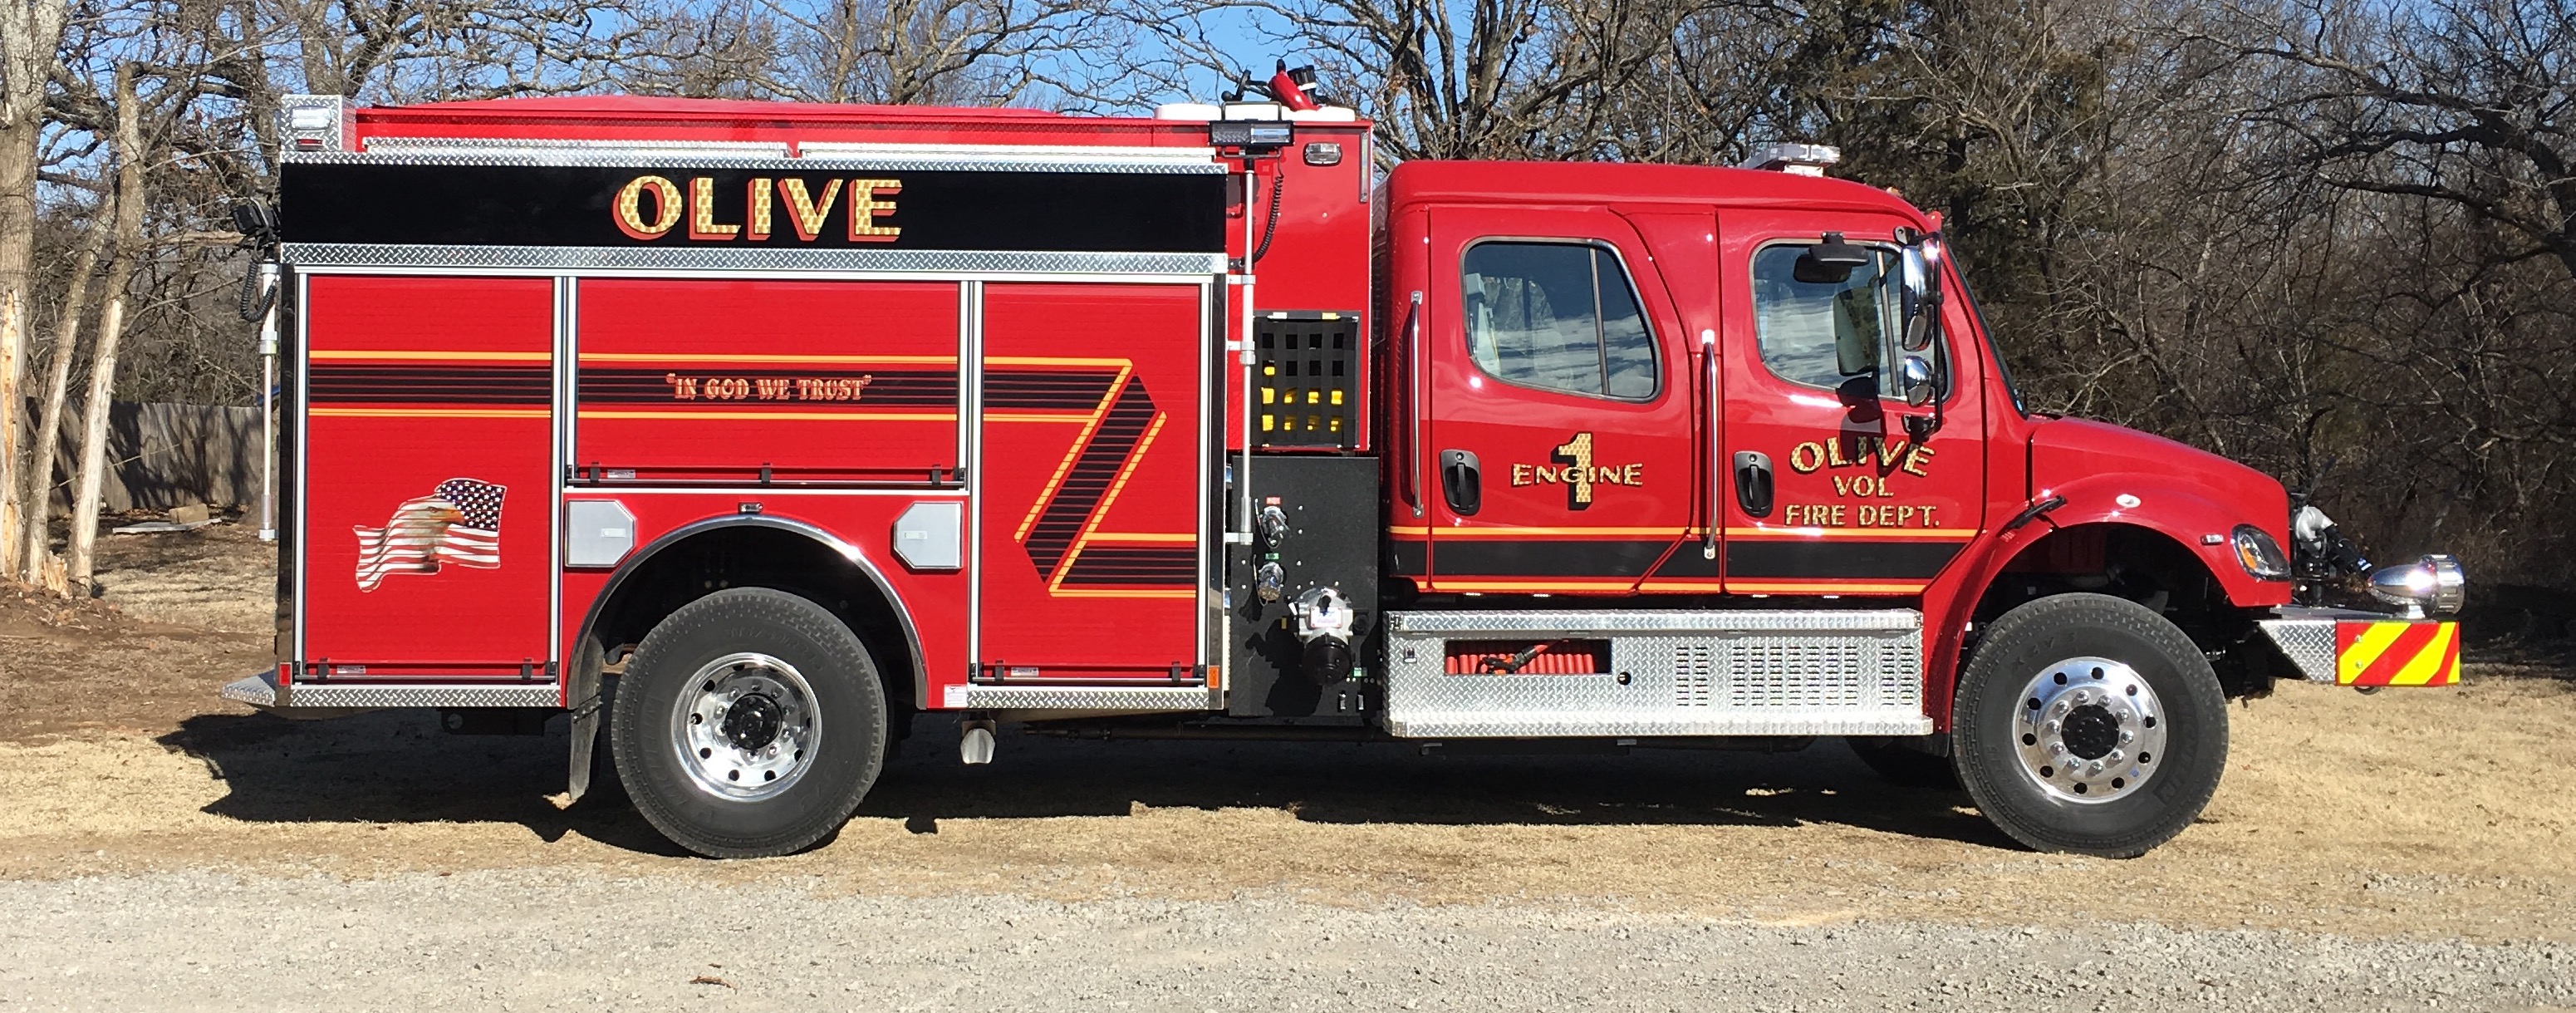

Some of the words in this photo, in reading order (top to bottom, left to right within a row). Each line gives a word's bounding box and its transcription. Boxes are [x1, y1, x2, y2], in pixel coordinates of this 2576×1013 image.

[612, 175, 902, 242] OLIVE
[704, 378, 749, 400] GOD
[756, 379, 790, 400] WE
[1790, 436, 1935, 477] OLIVE
[1511, 463, 1644, 488] ENGINE
[1551, 431, 1592, 510] 1
[1833, 475, 1895, 497] VOL
[1785, 504, 1847, 526] FIRE
[1858, 504, 1941, 527] DEPT.
